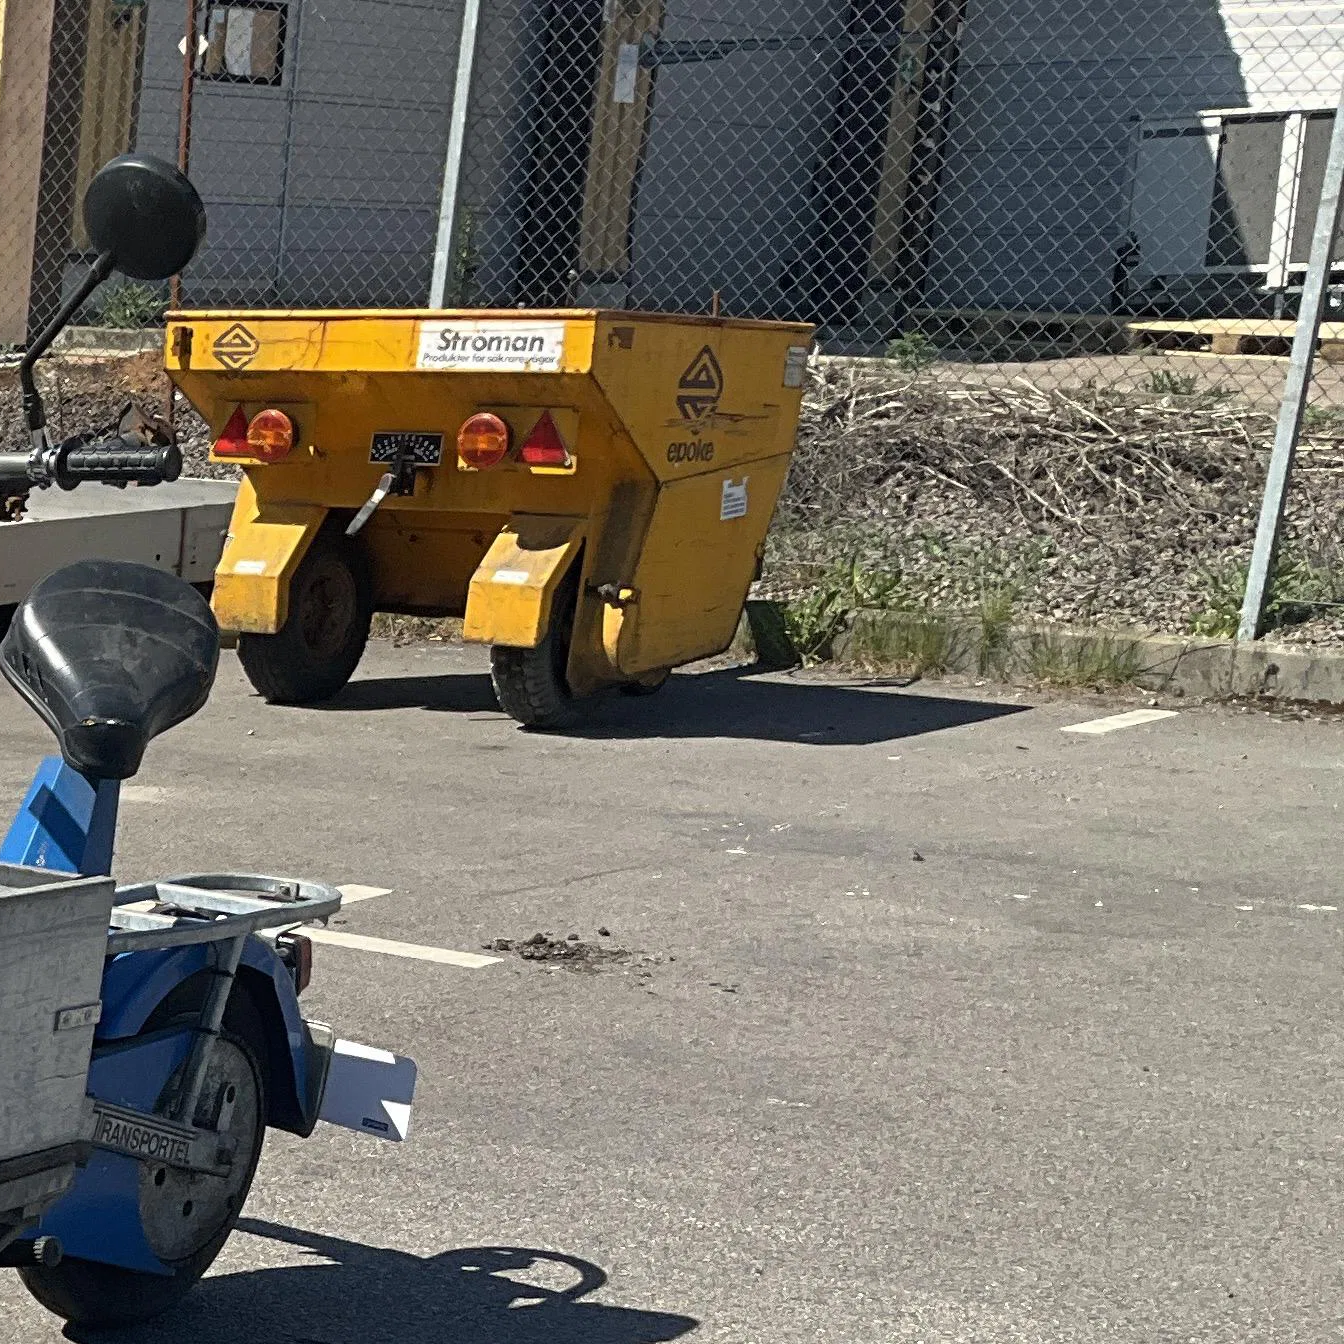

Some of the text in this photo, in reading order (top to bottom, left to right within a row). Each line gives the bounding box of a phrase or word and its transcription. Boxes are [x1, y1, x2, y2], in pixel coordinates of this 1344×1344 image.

[437, 328, 544, 352] Ströman
[423, 353, 470, 362] Produkter
[667, 439, 714, 464] epoke
